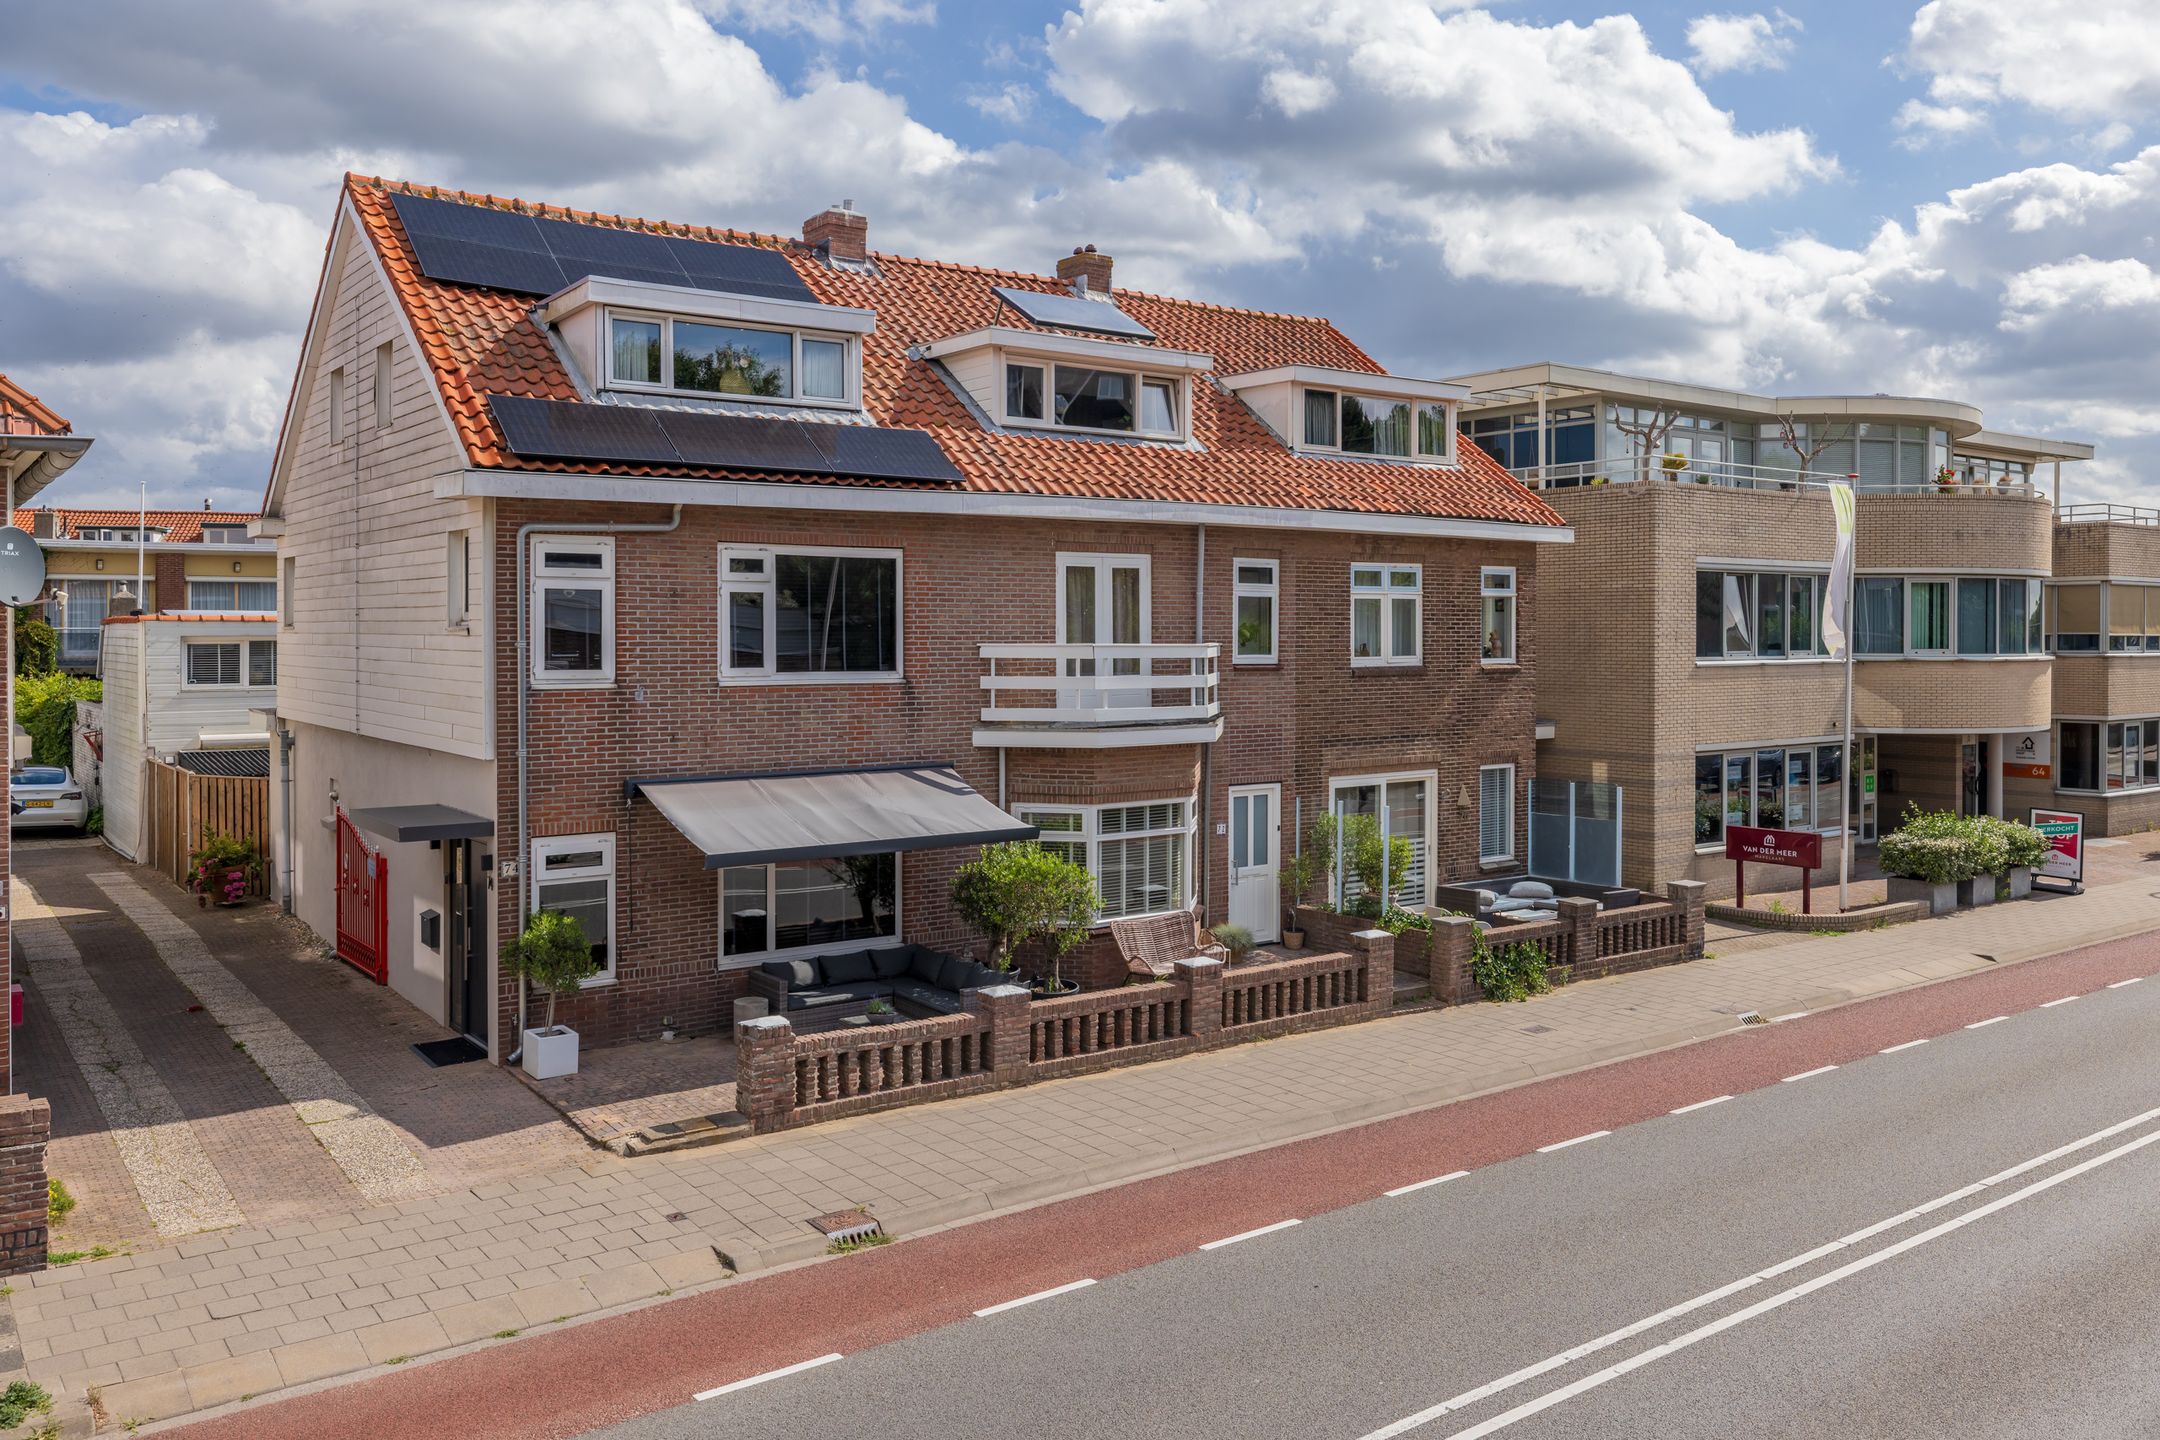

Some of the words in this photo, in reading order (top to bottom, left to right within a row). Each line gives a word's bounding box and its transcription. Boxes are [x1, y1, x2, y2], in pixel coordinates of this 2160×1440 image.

[2032, 766, 2045, 776] 64
[2042, 825, 2075, 833] ERKOCHT
[1759, 847, 1775, 855] DER
[1776, 849, 1797, 857] MEER
[504, 863, 518, 873] 74
